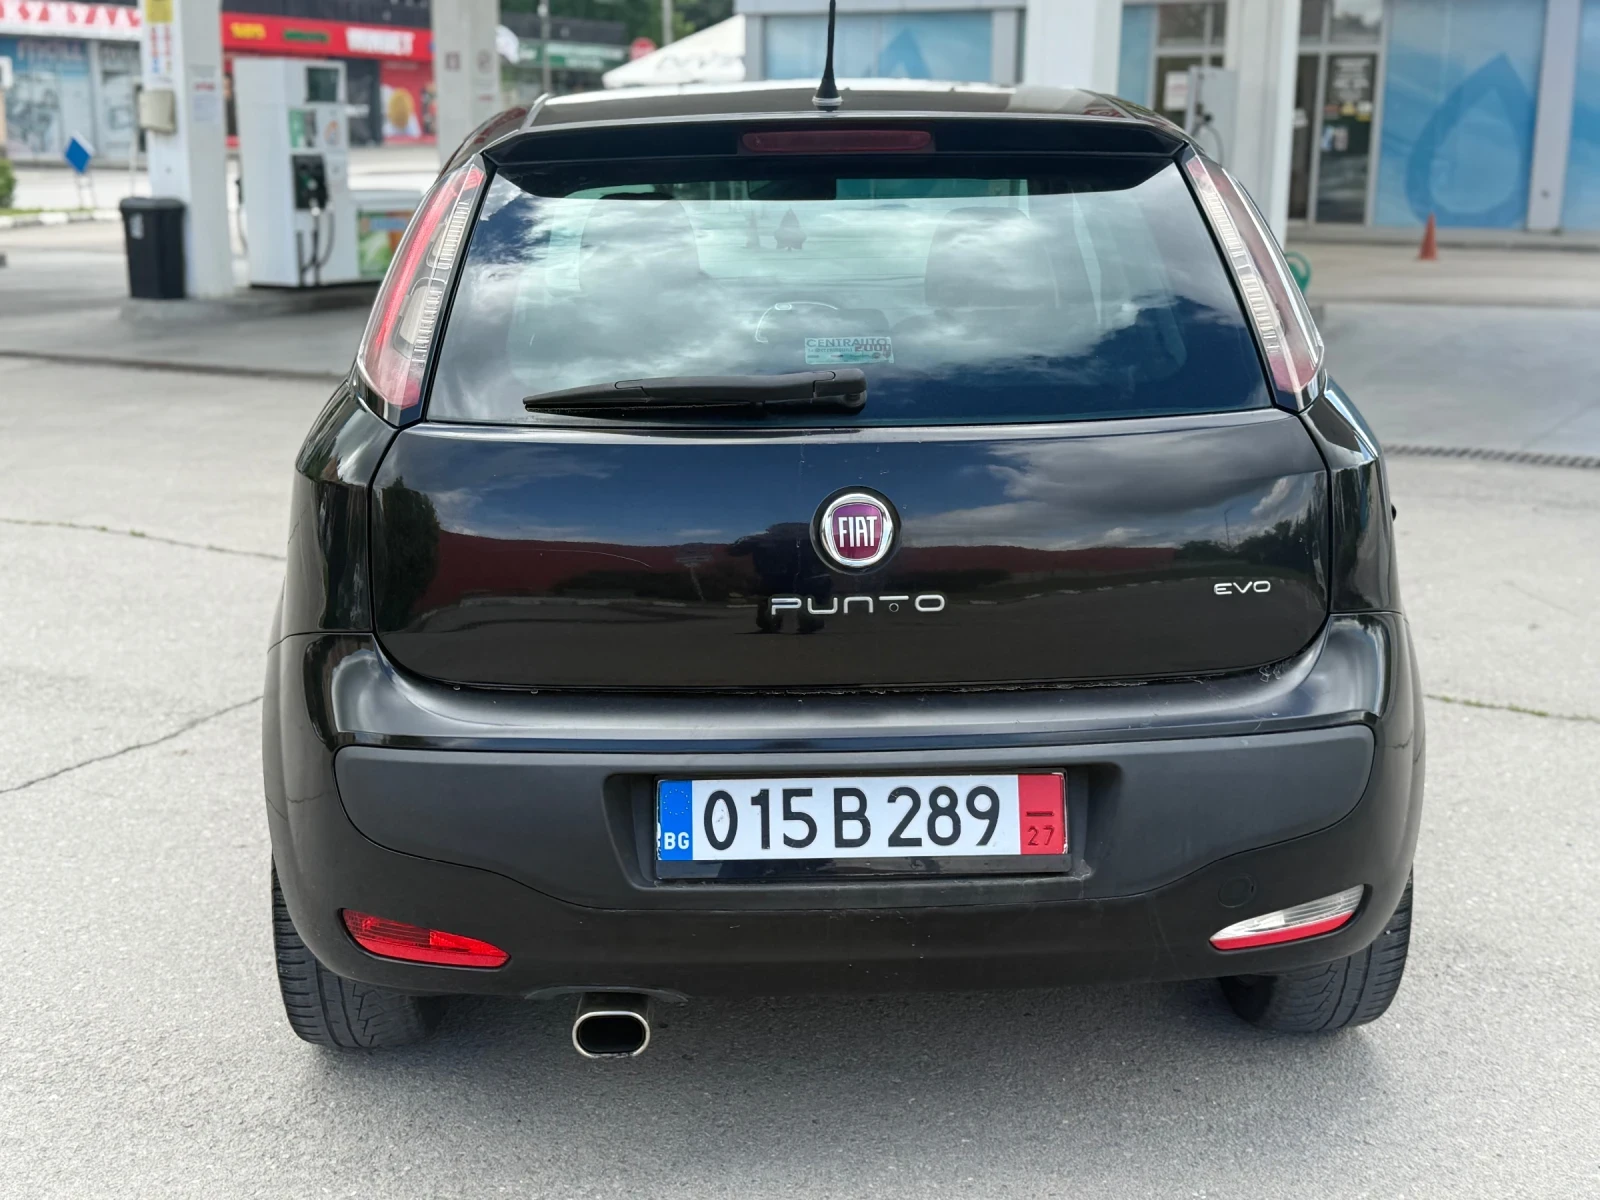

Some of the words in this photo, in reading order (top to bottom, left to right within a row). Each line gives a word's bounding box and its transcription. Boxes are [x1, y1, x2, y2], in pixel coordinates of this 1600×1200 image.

[806, 338, 888, 347] CENTRAUTO
[838, 516, 878, 548] FIAT
[1213, 580, 1271, 595] EVO
[770, 594, 945, 615] PUNTO
[663, 833, 690, 850] BG
[1027, 825, 1055, 846] 27
